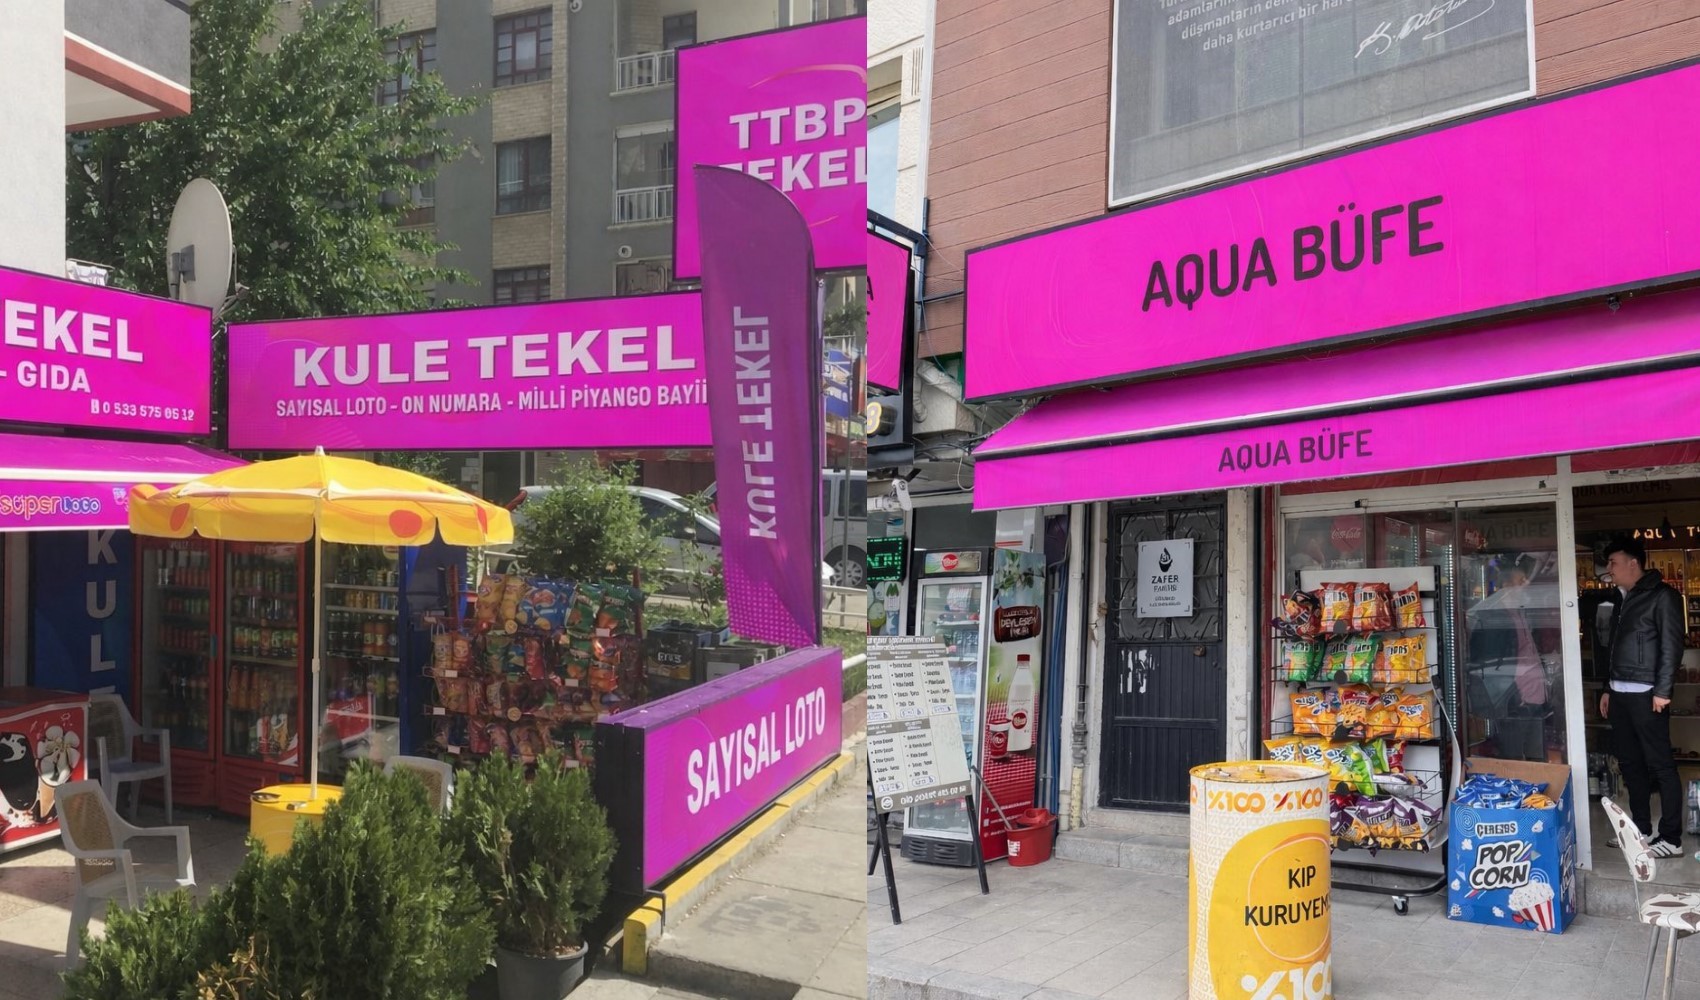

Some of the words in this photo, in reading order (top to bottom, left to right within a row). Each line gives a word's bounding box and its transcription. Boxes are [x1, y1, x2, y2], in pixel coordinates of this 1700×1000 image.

[1181, 3, 1262, 40] düşmanların
[1203, 33, 1233, 51] daha
[1236, 12, 1295, 40] kurtarıcı
[1298, 4, 1318, 19] bir
[729, 98, 867, 149] TTBP
[719, 147, 867, 192] EKEL
[1142, 237, 1278, 312] AQUA
[1293, 195, 1444, 281] BÜFE
[4, 299, 143, 363] EKEL
[294, 340, 449, 386] KULE
[468, 325, 696, 379] TEKEL
[17, 360, 91, 393] GIDA
[103, 401, 110, 413] 0
[114, 402, 136, 416] 533
[140, 405, 161, 418] 575
[276, 398, 342, 417] SAYISAL
[346, 397, 387, 415] LOTO
[401, 395, 424, 414] ON
[429, 392, 502, 413] NUMARA
[518, 386, 565, 410] MİLLİ
[571, 384, 651, 408] PİYANGO
[657, 379, 707, 406] BAYİİ
[1218, 439, 1291, 472] AQUA
[1299, 427, 1373, 464] BÜFE
[1151, 575, 1179, 584] ZAFER
[86, 529, 118, 697] KUL
[687, 712, 781, 814] SAYISAL
[785, 687, 826, 755] LOTO
[1208, 790, 1266, 813] %100
[1273, 787, 1322, 811] %100
[1480, 843, 1521, 865] POP
[1288, 865, 1317, 889] KIP
[1472, 864, 1528, 887] CORN
